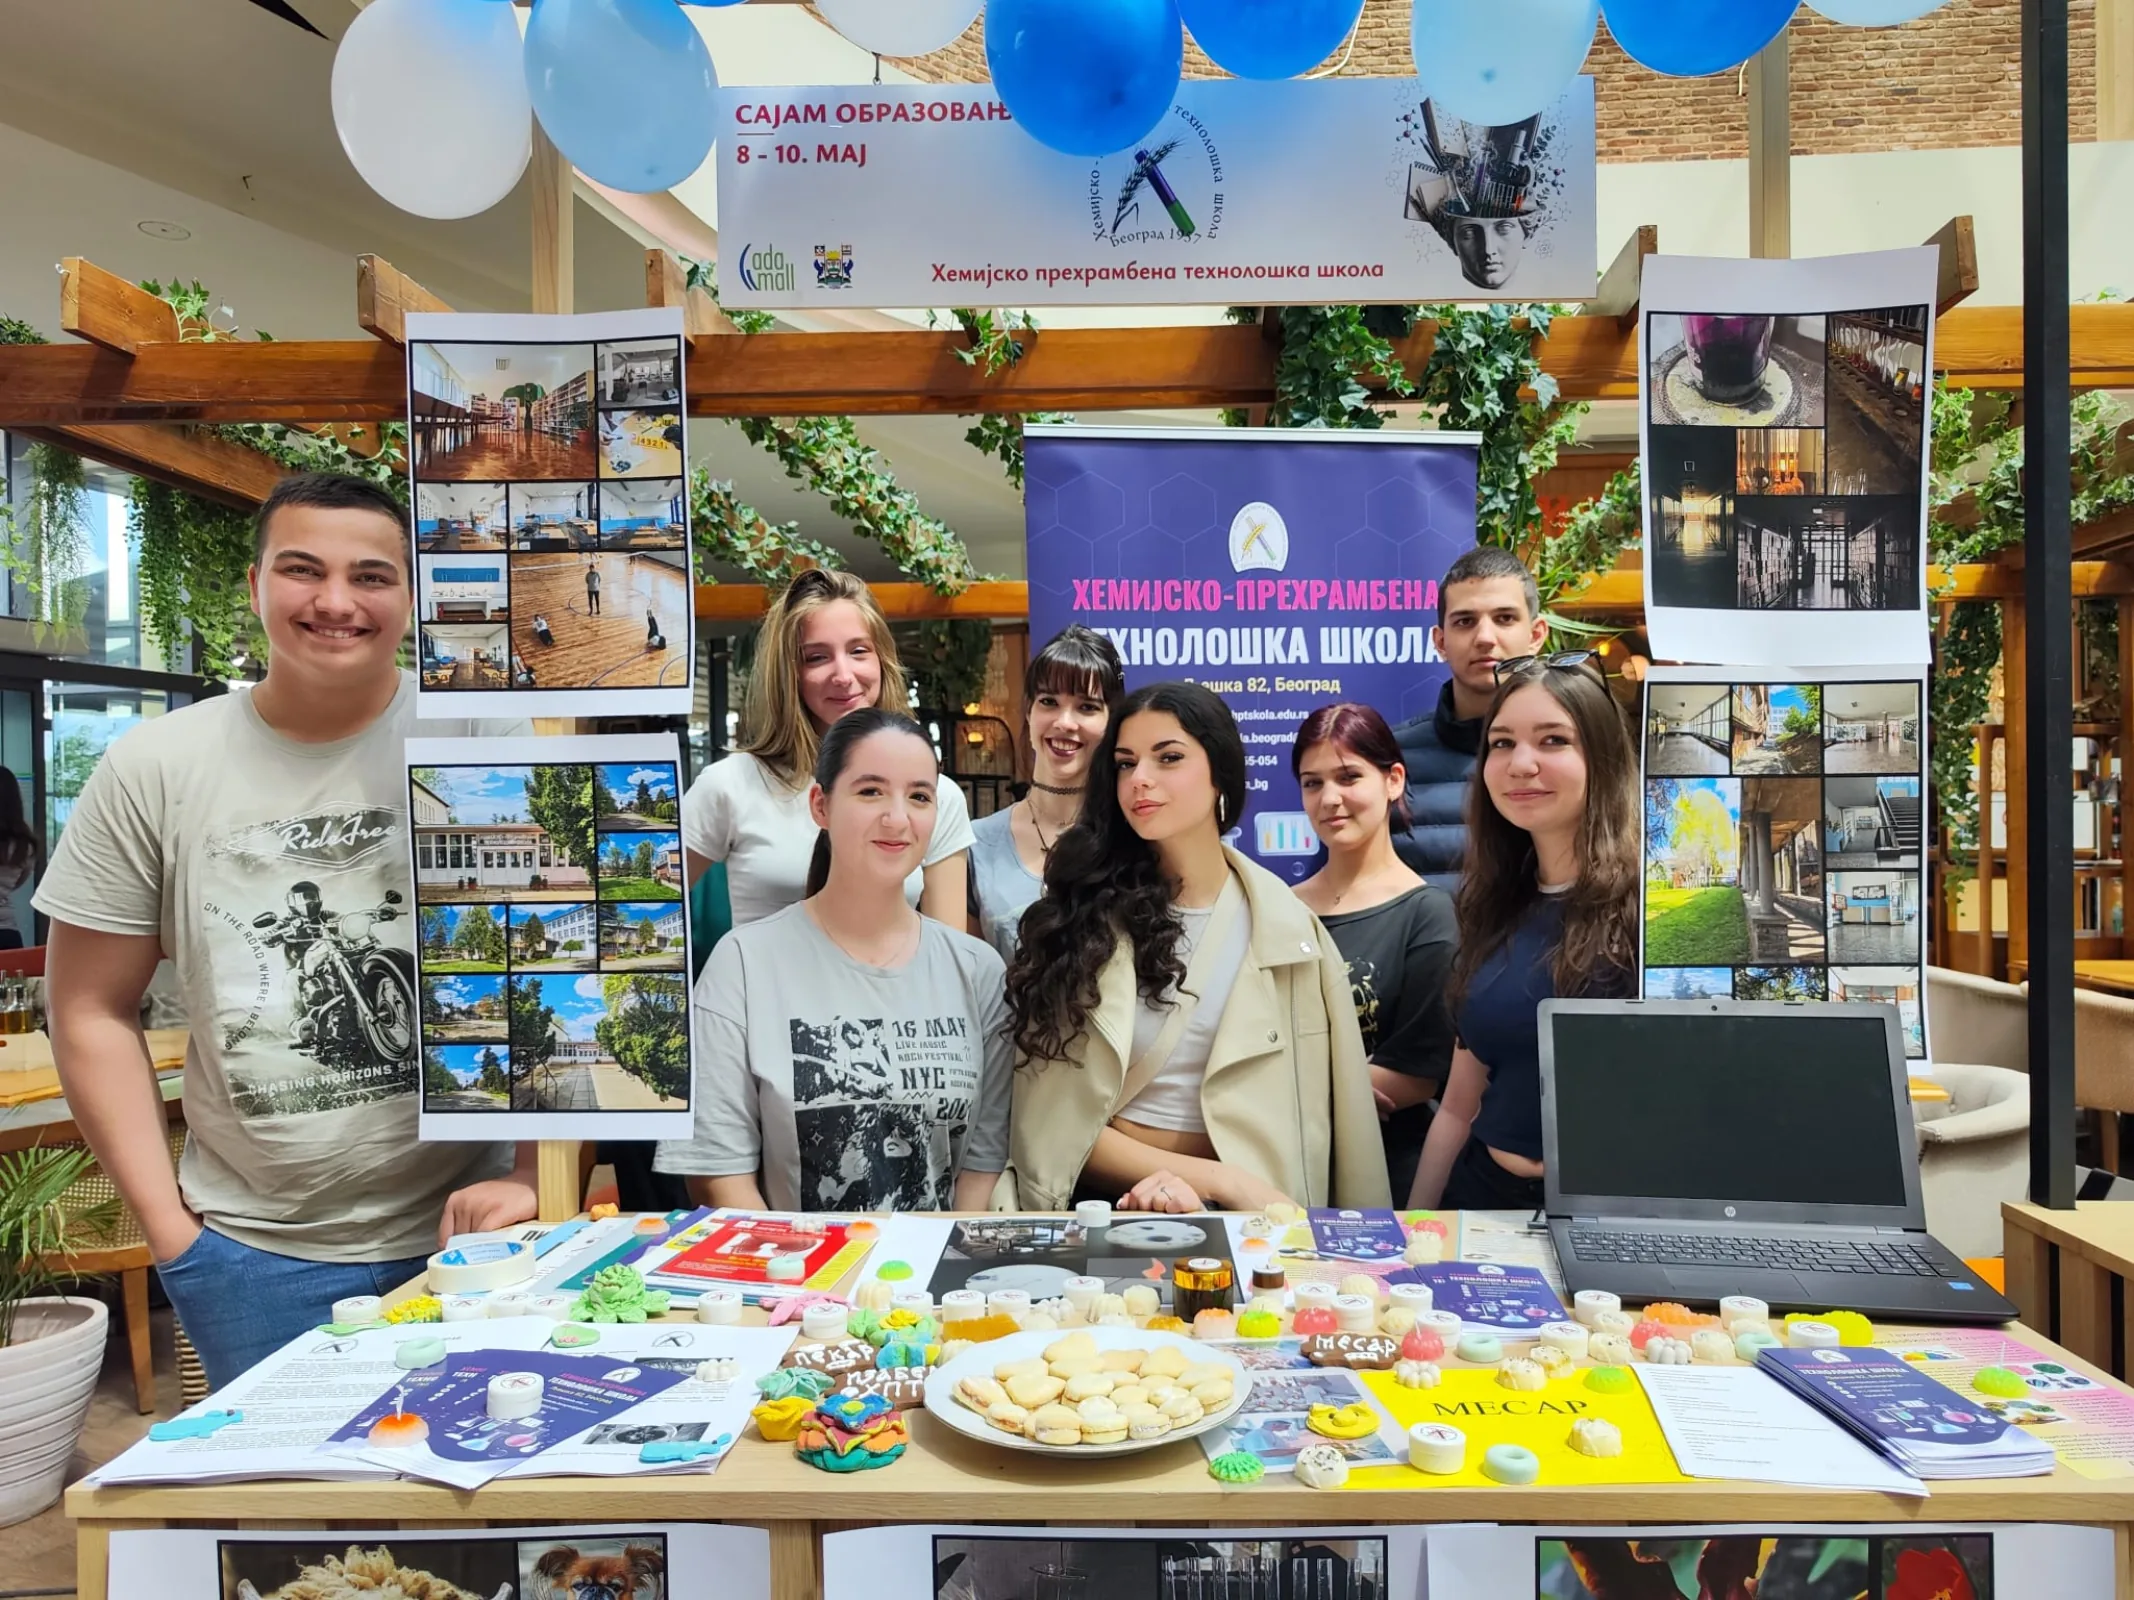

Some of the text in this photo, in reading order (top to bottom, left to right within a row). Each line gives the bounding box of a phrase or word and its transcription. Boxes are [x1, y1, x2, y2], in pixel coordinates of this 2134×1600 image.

[735, 103, 826, 129] САЈАМ
[736, 145, 750, 164] 8
[774, 144, 807, 164] 10.
[816, 144, 867, 168] МАЈ
[752, 243, 784, 270] ada
[756, 264, 795, 291] mall
[931, 260, 1384, 289] Хемијско прехрамбена технолошка школа
[1072, 578, 1438, 612] ХЕМИЈСКО-ПРЕХРАМБЕНА
[1320, 626, 1443, 664] ШКОЛА
[1247, 677, 1271, 694] 82,
[1275, 677, 1341, 694] Београд
[203, 902, 221, 915] ON
[223, 912, 245, 931] THE
[243, 931, 265, 960] ROAD
[257, 963, 270, 1003] WHERE
[225, 1012, 259, 1051] BELONG
[892, 1017, 966, 1038] 16 MAY
[249, 1077, 316, 1095] CHASING
[321, 1064, 392, 1085] HORIZONS
[900, 1067, 945, 1090] NYC
[1432, 1400, 1588, 1416] МЕСАР
